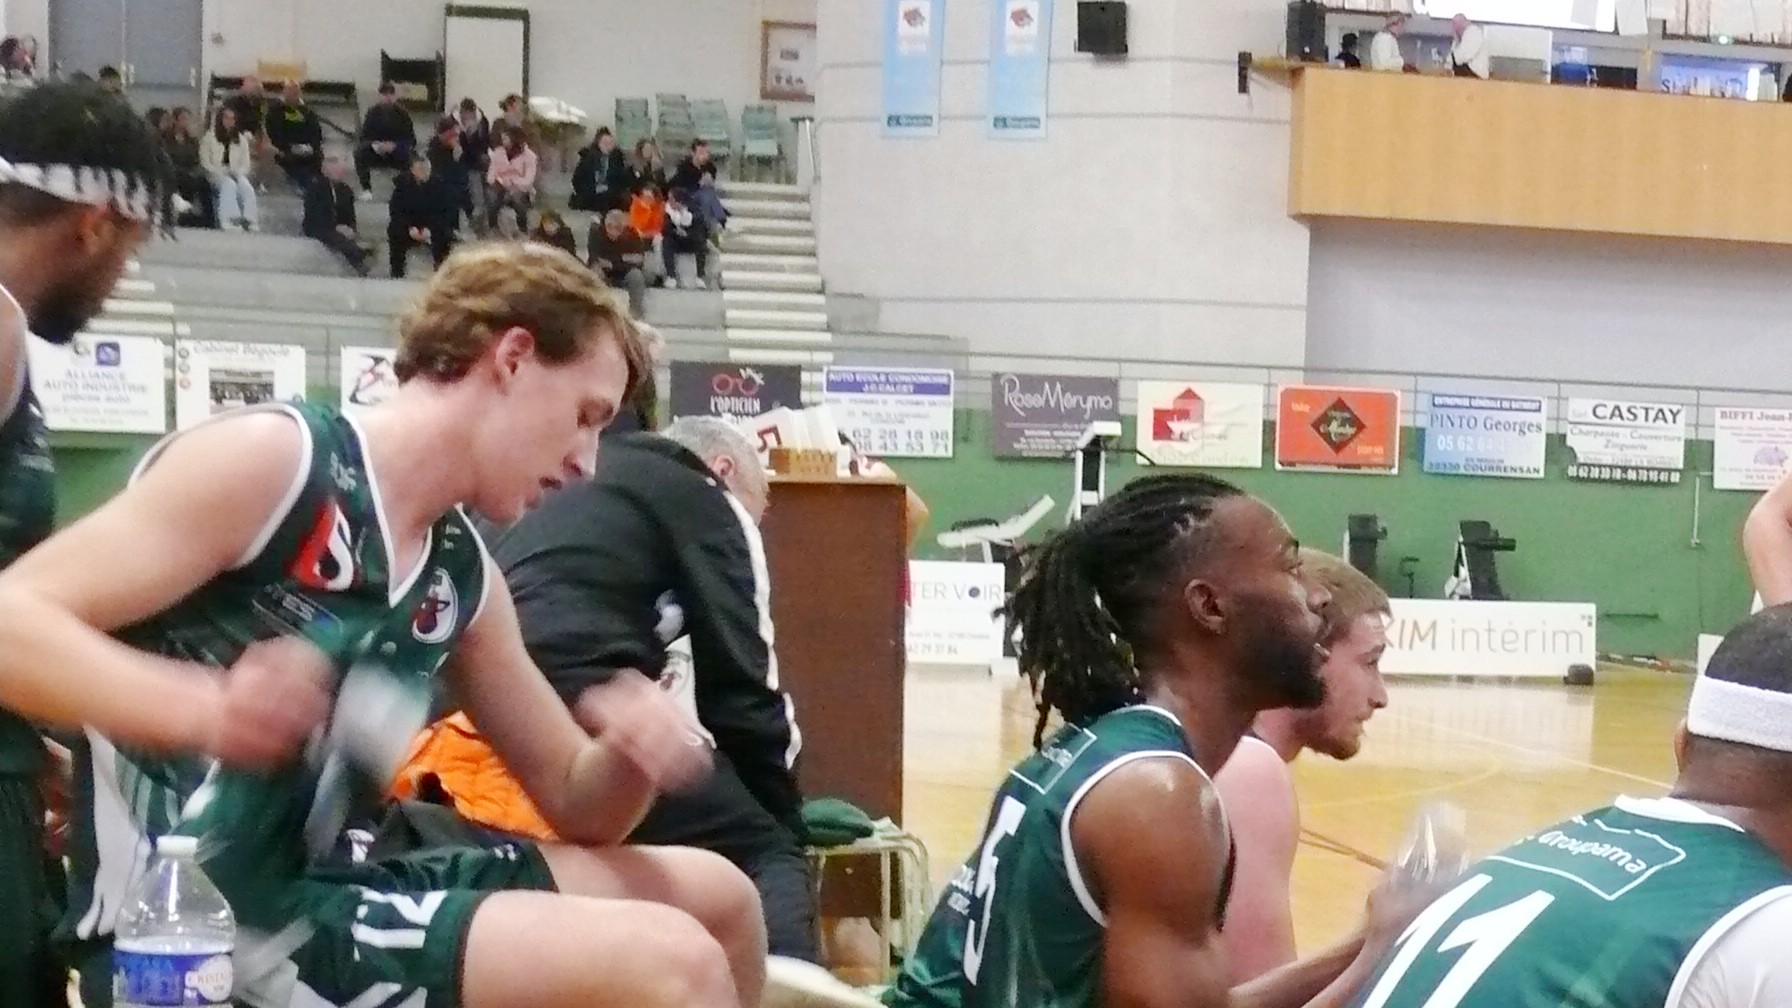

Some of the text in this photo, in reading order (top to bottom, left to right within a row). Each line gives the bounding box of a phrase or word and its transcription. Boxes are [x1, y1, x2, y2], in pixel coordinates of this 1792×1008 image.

[64, 368, 128, 380] ALLIANCE
[43, 380, 149, 394] AUTO INDUSTRIE
[1591, 403, 1682, 425] CASTAY
[1719, 410, 1754, 421] BIFFI
[1429, 413, 1543, 436] PINTO Georges
[1437, 435, 1454, 450] 05
[1456, 435, 1475, 451] 62
[1450, 618, 1584, 654] intérim
[1538, 829, 1647, 874] Groupama
